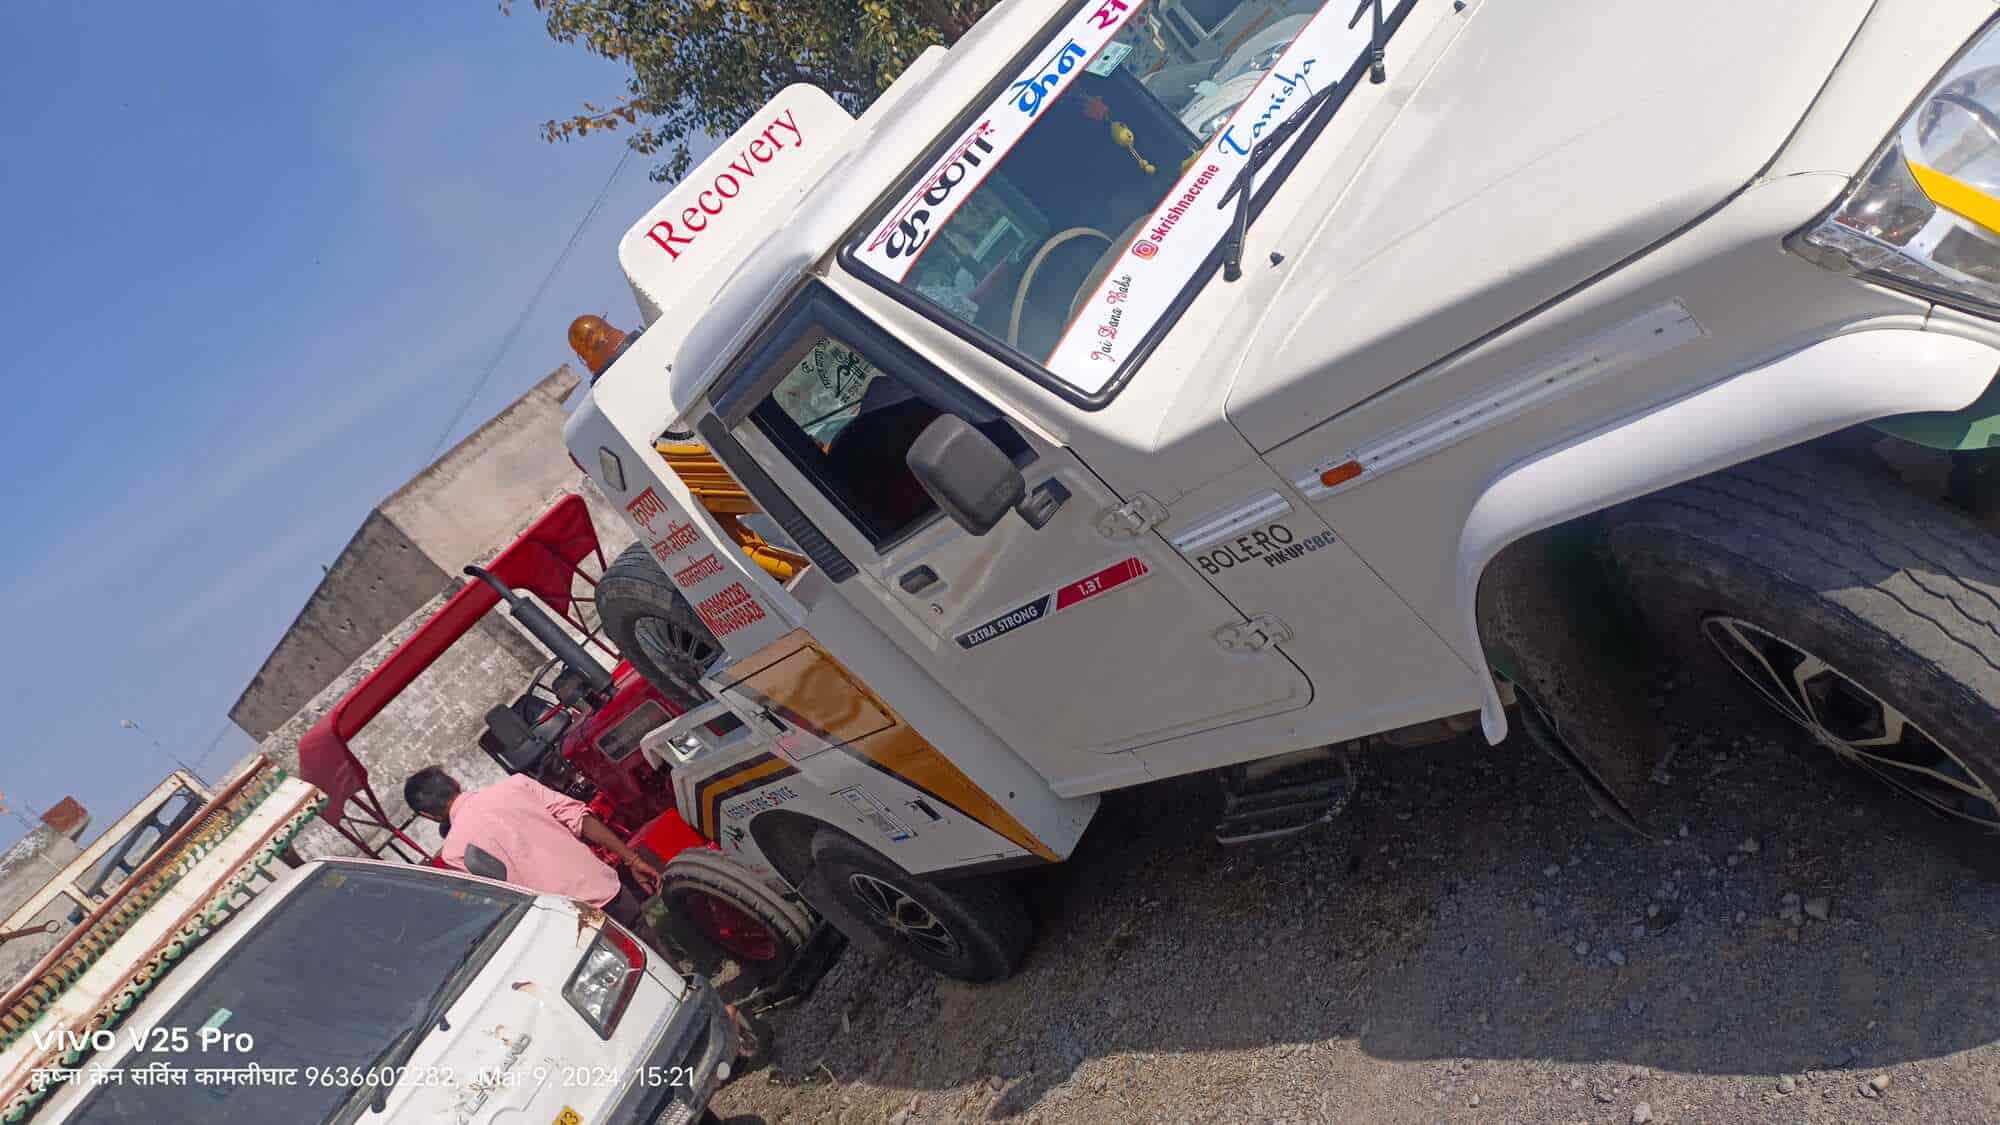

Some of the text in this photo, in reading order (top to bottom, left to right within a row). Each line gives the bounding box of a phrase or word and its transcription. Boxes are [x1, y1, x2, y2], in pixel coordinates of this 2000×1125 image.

[1008, 38, 1087, 117] क्रेन
[1217, 58, 1316, 157] Tanisha
[643, 108, 803, 263] Recovery
[1150, 163, 1220, 243] skrishnacrene
[1196, 523, 1294, 575] BOLERO
[967, 576, 1103, 645] EXTRA STRONG 1.3T
